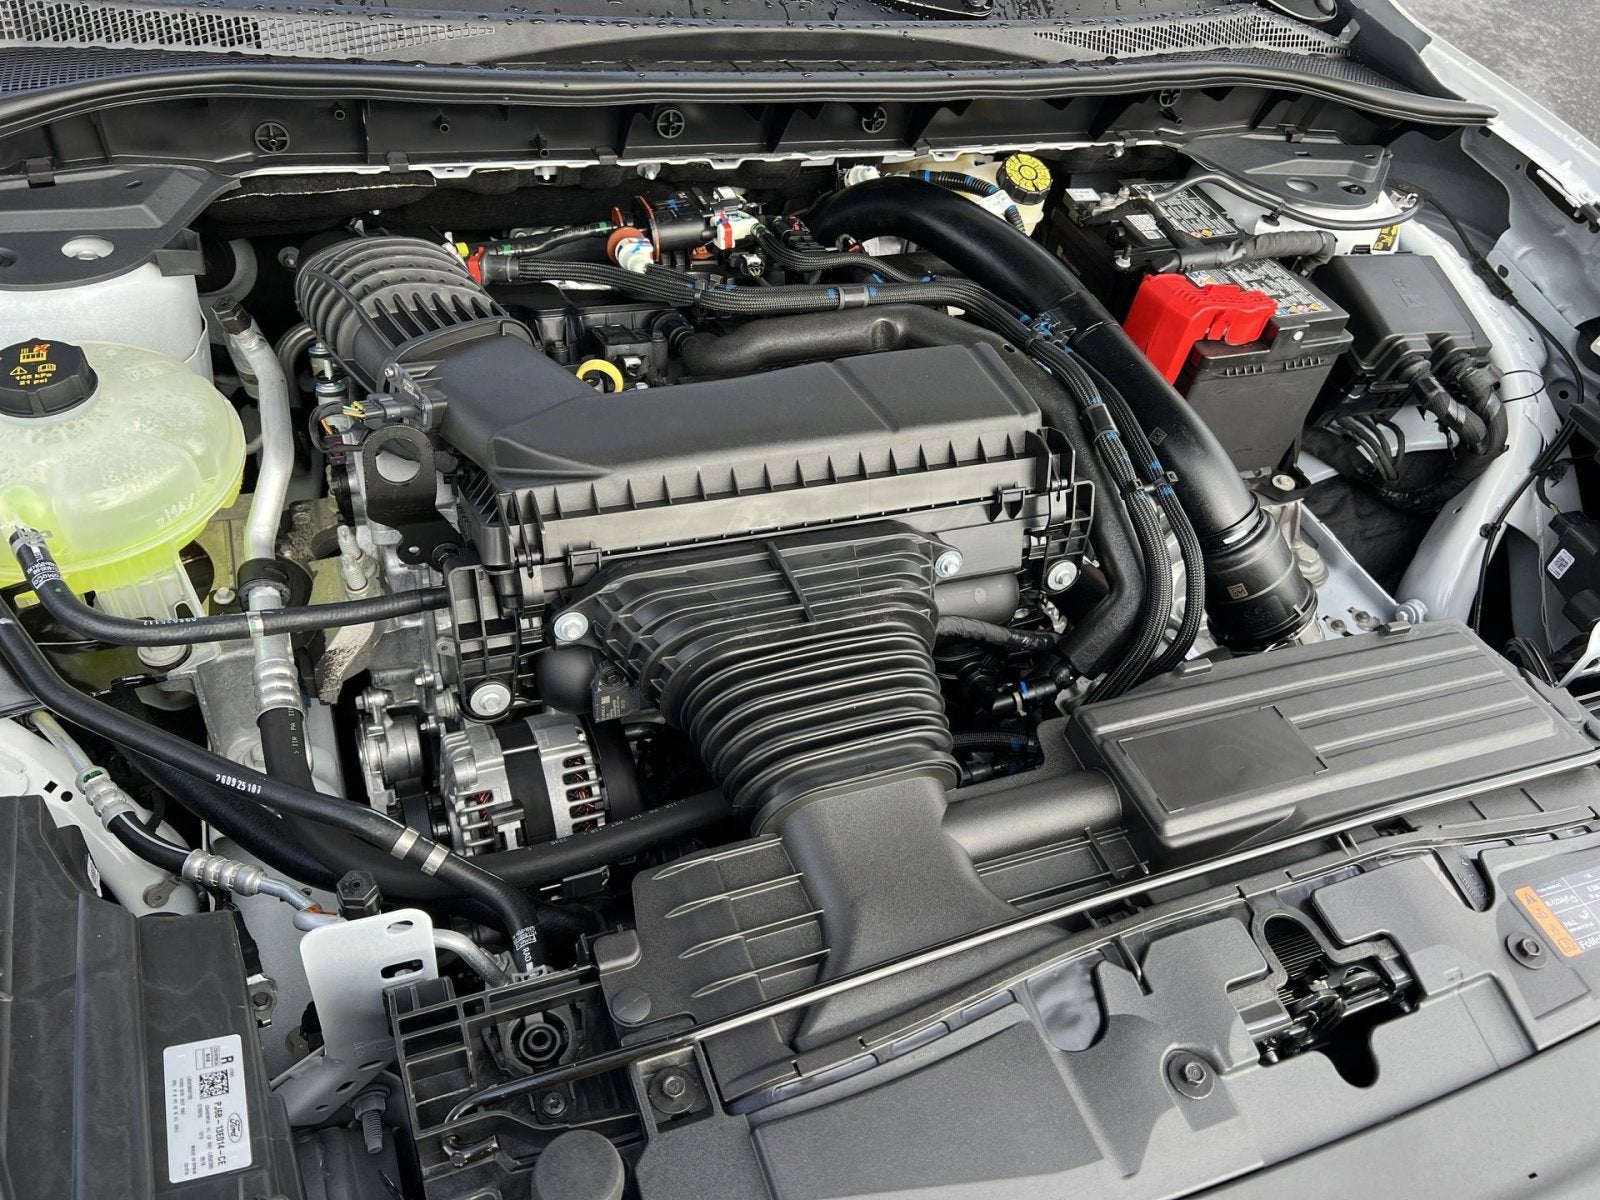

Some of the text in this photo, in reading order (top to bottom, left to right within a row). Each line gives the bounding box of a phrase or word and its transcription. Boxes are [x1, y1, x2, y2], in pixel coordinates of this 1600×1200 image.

[522, 946, 532, 963] RAD
[221, 1055, 234, 1065] R
[229, 1118, 240, 1139] Ford
